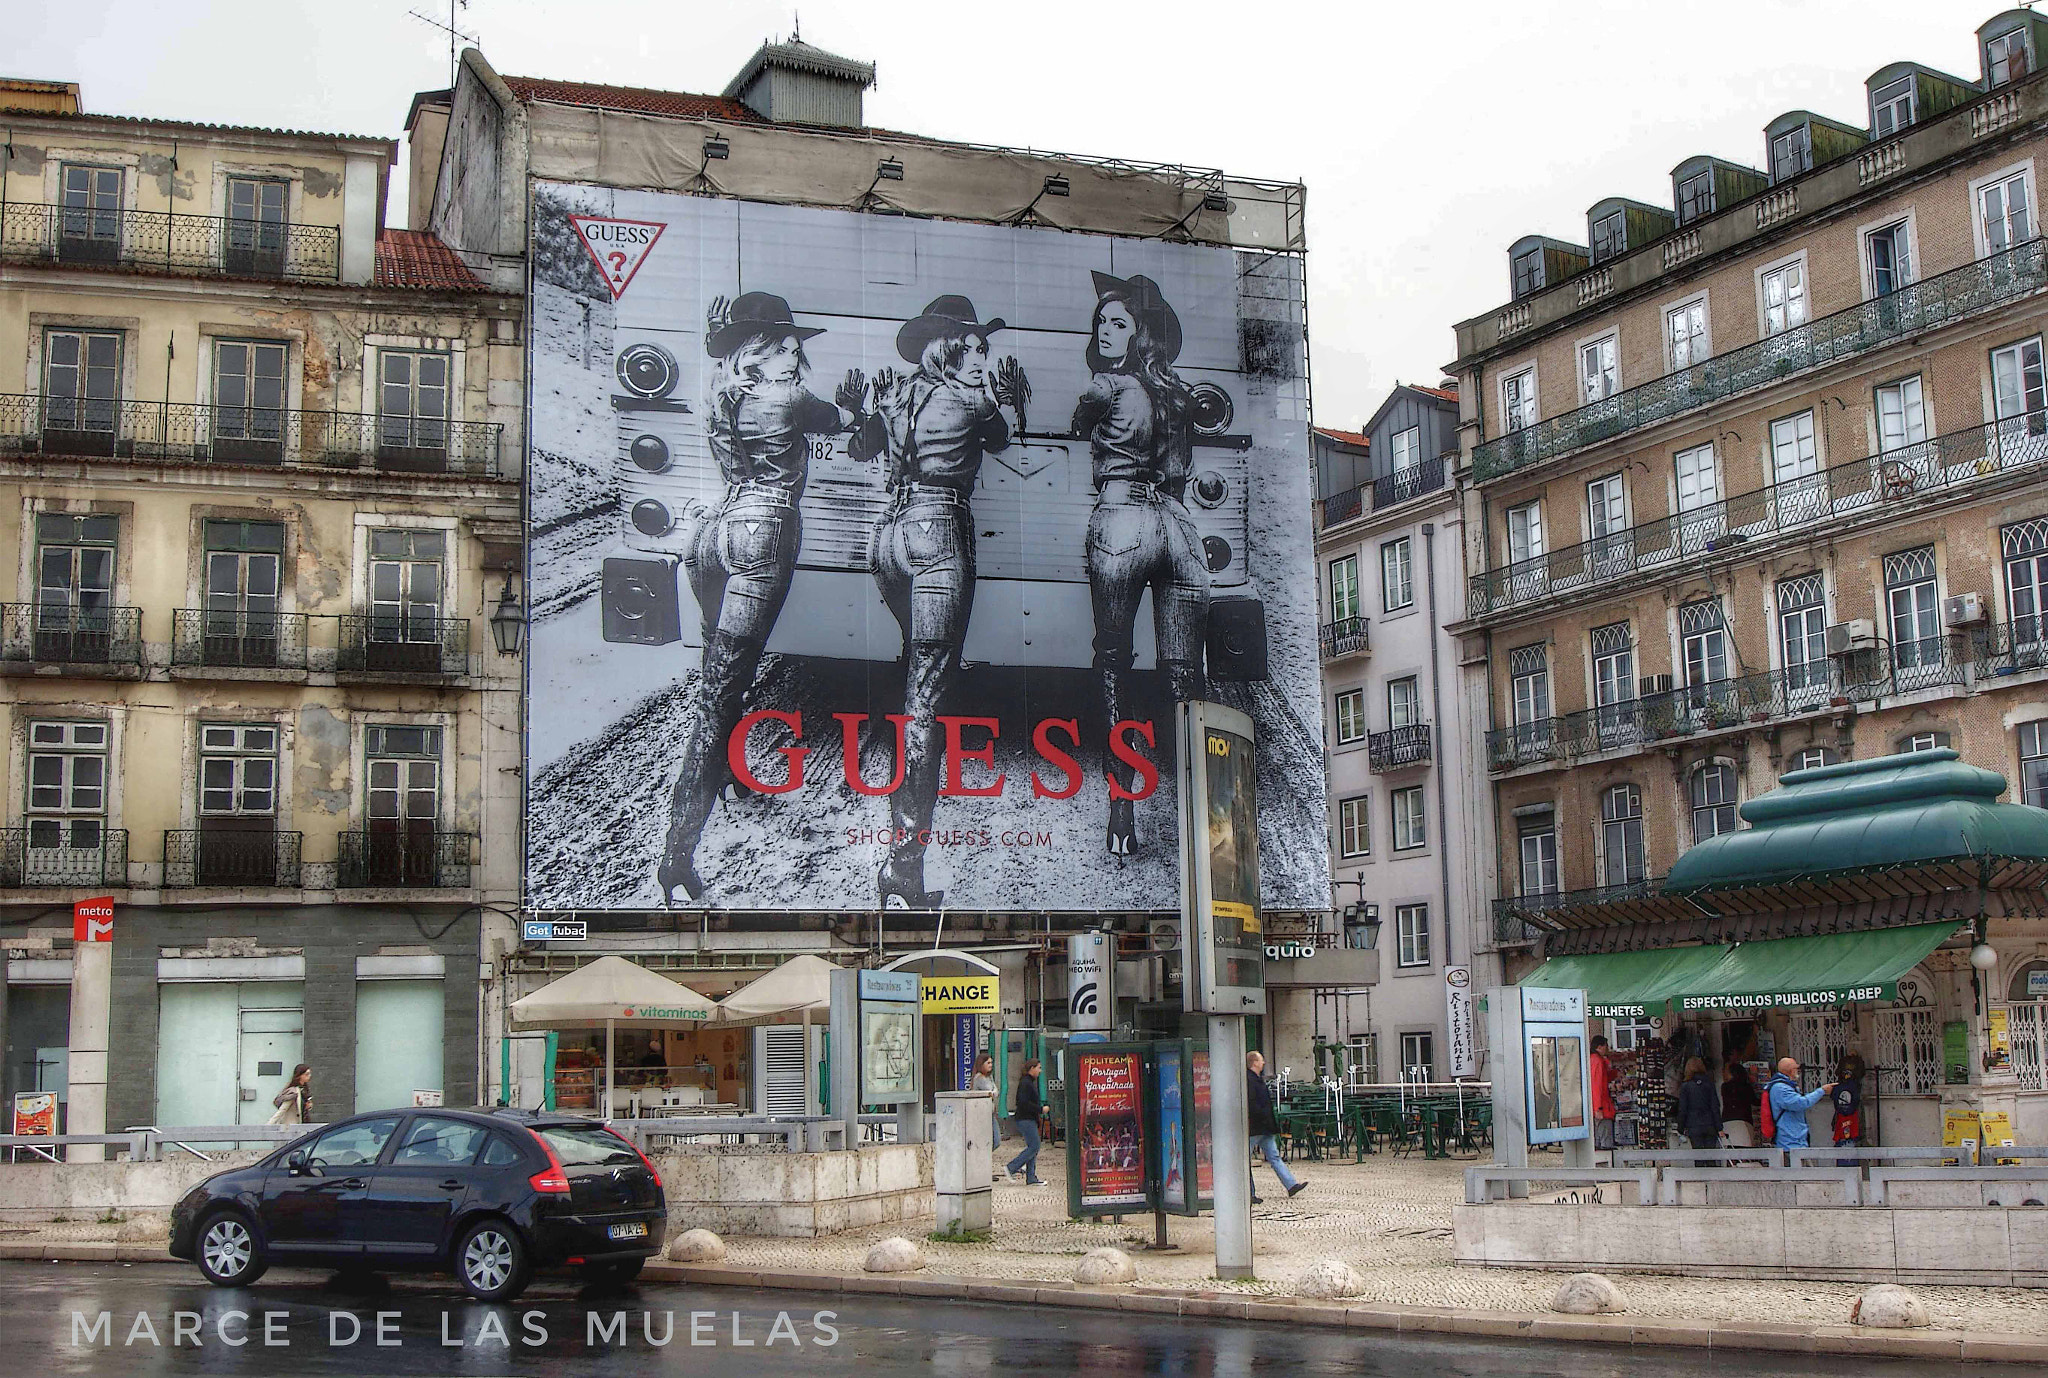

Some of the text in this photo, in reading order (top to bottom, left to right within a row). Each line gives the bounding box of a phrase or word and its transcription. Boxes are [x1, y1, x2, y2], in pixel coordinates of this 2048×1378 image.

[585, 224, 649, 244] GUESS
[727, 709, 1160, 801] GUESS
[79, 906, 113, 916] metro
[527, 926, 549, 936] Get
[1682, 986, 1883, 1009] ESPECTÁCULOS PUBLICOS ABEP
[639, 1007, 708, 1020] vitaminas
[1594, 1005, 1645, 1017] BILHETES
[1450, 992, 1463, 1071] Ristorante
[962, 1017, 971, 1065] EXCHANGE
[1084, 1056, 1134, 1065] POLITEAMA
[1091, 1066, 1128, 1078] Portugal
